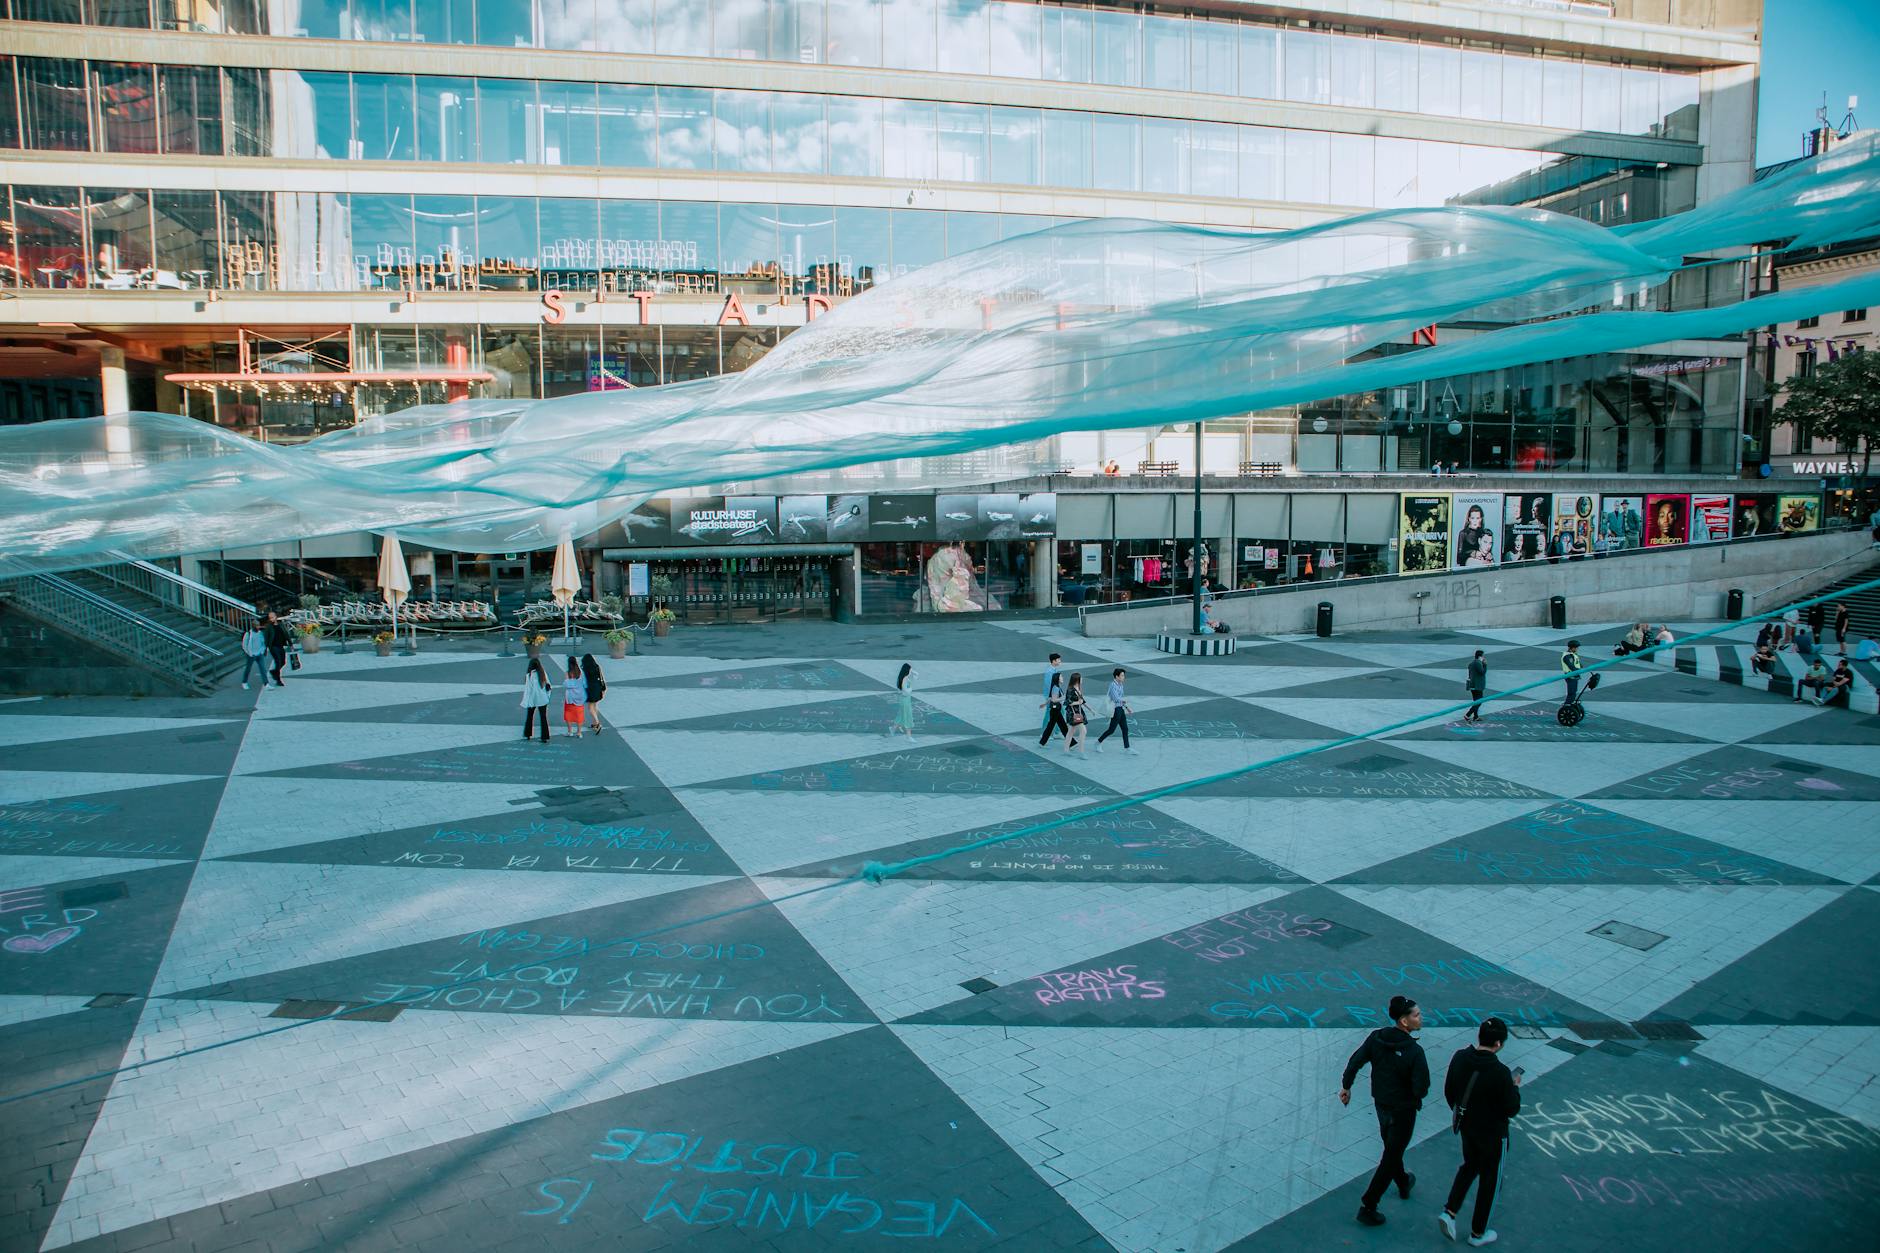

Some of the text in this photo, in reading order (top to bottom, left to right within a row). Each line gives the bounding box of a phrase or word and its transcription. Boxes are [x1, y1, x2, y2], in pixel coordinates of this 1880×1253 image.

[690, 510, 757, 520] KULTURHUSET
[690, 520, 756, 530] stadsteatern
[1650, 536, 1683, 544] random
[1624, 765, 1722, 793] LOVE
[1701, 767, 1784, 798] OTHERS
[501, 855, 541, 870] PÅ
[969, 860, 983, 868] B
[988, 861, 1056, 871] PLANET
[1092, 863, 1115, 871] IS
[1121, 863, 1169, 871] THERE
[1161, 920, 1223, 950] EAT
[1228, 905, 1287, 936] FIGS
[1195, 913, 1333, 962] NOT PIGS
[460, 929, 766, 962] CHOOSE VEGAN
[605, 968, 732, 992] THEY
[1027, 964, 1138, 989] TRANS
[1226, 966, 1362, 997] WATCH
[557, 989, 587, 1012] A
[591, 989, 711, 1016] HAVE
[736, 993, 846, 1019] YOU
[1034, 980, 1166, 1007] RIGHTS
[1211, 1000, 1327, 1028] GAY
[1760, 1089, 1806, 1117] A
[1526, 1126, 1689, 1160] MORAL
